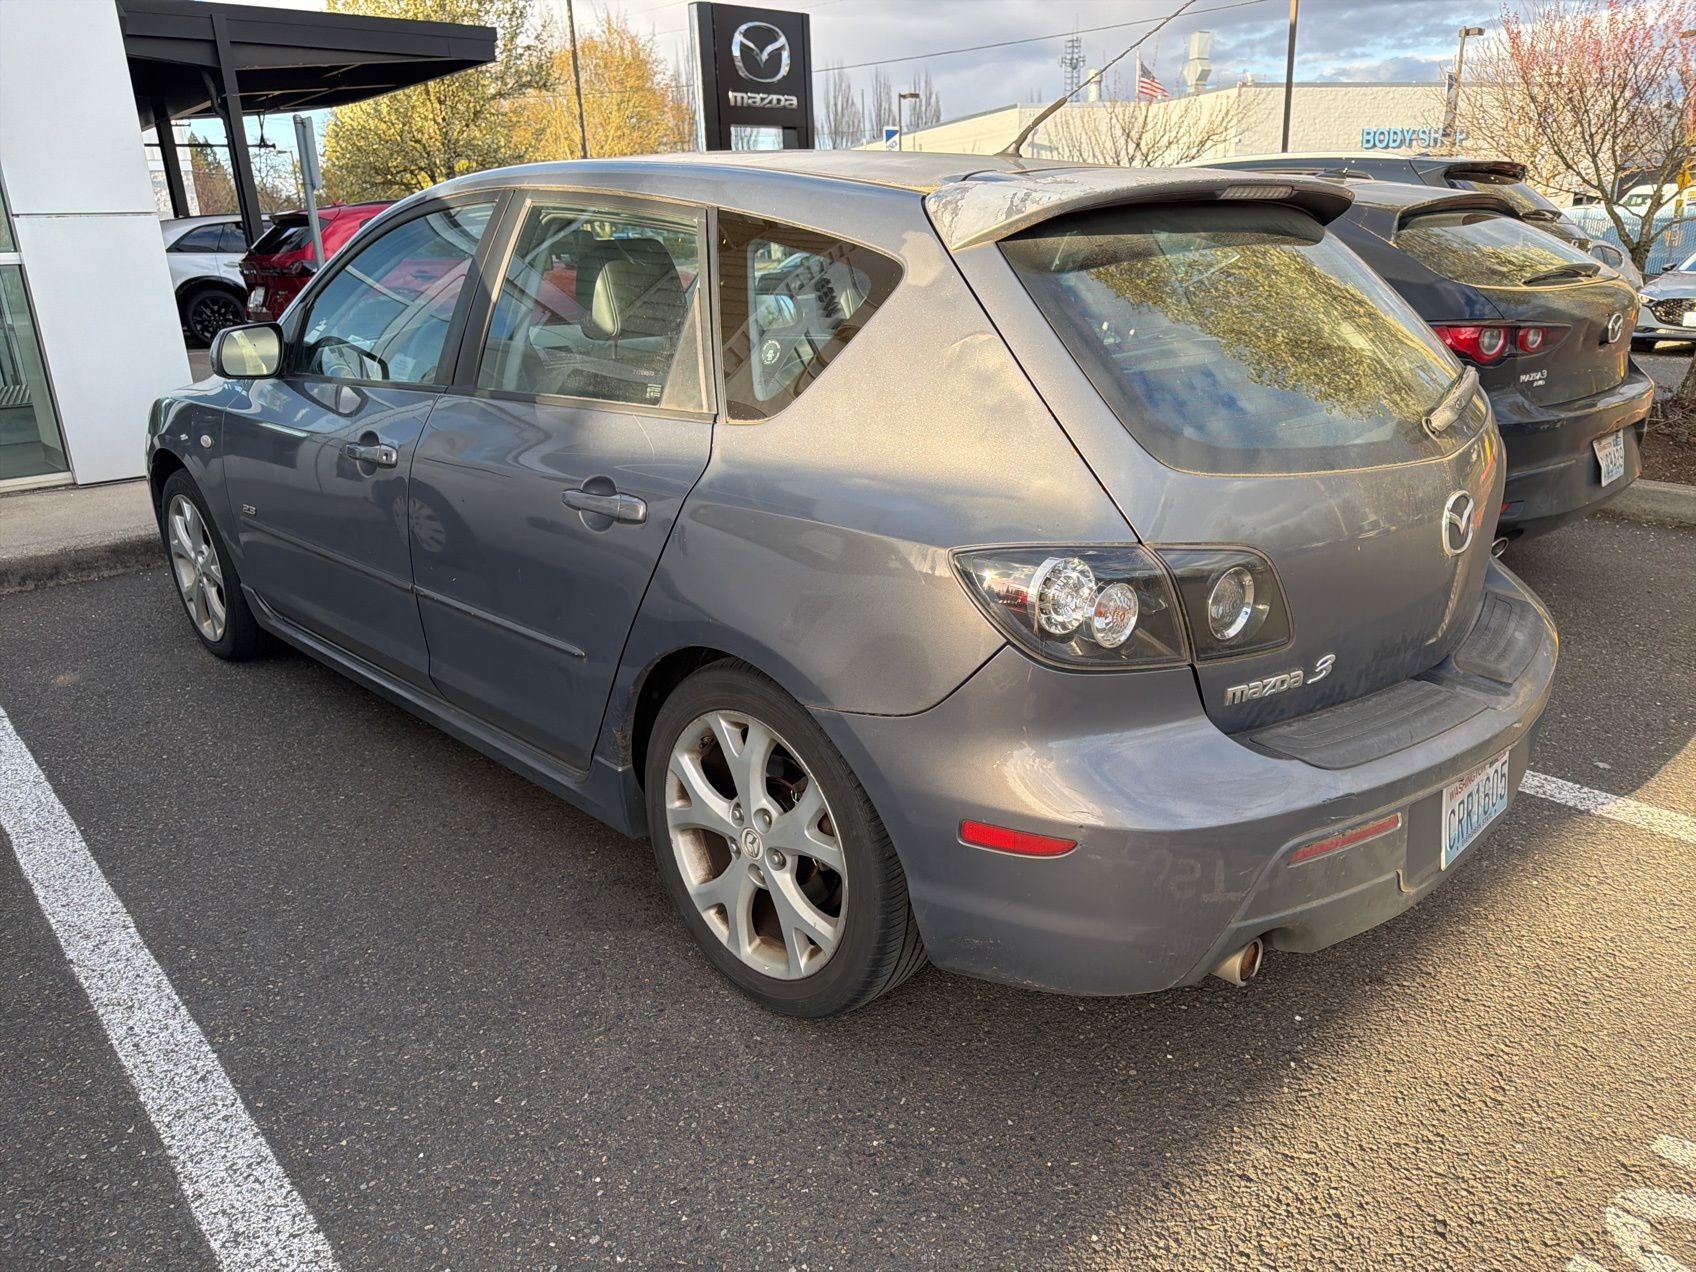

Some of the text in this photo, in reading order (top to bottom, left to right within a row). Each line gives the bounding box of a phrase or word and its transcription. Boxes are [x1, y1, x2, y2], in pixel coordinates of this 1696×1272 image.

[728, 90, 798, 109] mazda
[1361, 126, 1468, 149] BODY SHP
[1224, 653, 1337, 706] mazda 3
[1447, 759, 1507, 851] CRR1605
